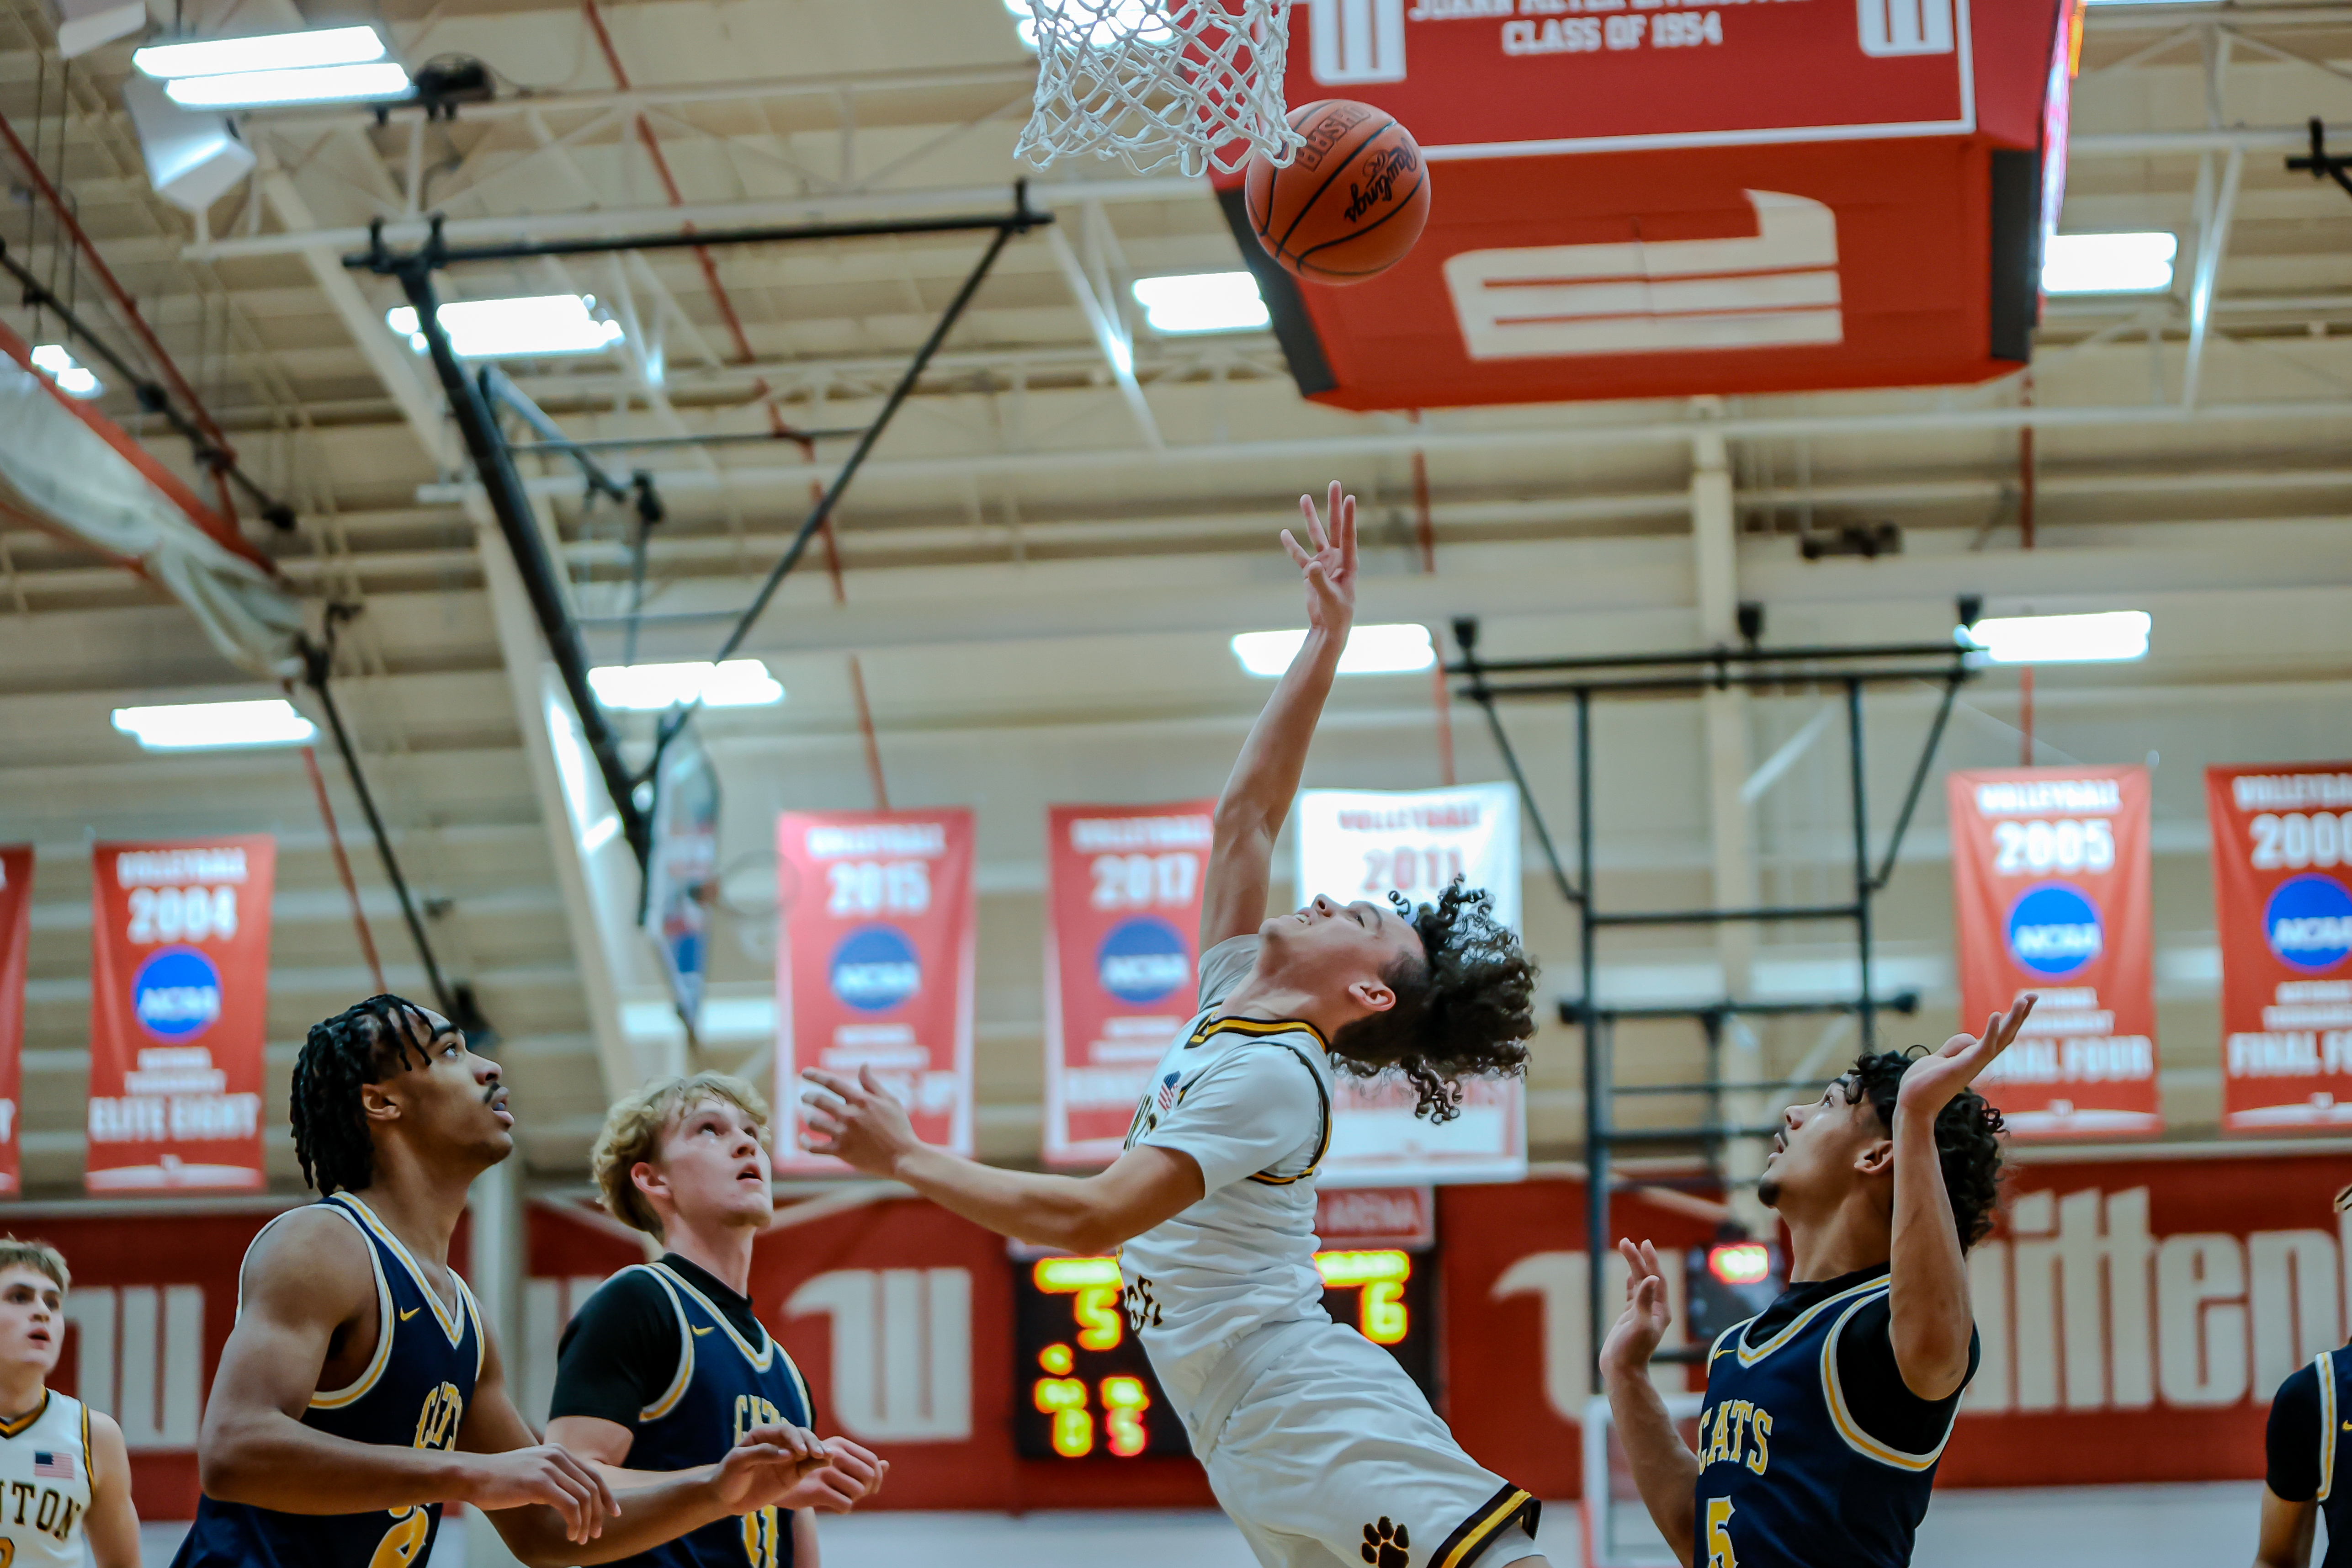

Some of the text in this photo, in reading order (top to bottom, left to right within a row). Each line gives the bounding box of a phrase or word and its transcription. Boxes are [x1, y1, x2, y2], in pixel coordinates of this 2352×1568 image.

[1503, 11, 1723, 56] CLASS OF 1954
[1344, 137, 1417, 223] Rawlings
[1338, 803, 1480, 831] VOLLEYBALL
[1364, 847, 1463, 891] 2011
[1992, 819, 2115, 875] 2005
[828, 861, 930, 916] 2015
[1089, 853, 1199, 909] 2017
[127, 885, 238, 944] 2004
[2012, 922, 2102, 959] NCAA
[833, 962, 921, 999] NCAA
[1101, 952, 1188, 989] NCAA
[138, 986, 222, 1023] NCAA
[1697, 1399, 1773, 1475] CATS
[0, 1479, 81, 1542] TON
[1707, 1495, 1739, 1568] 5
